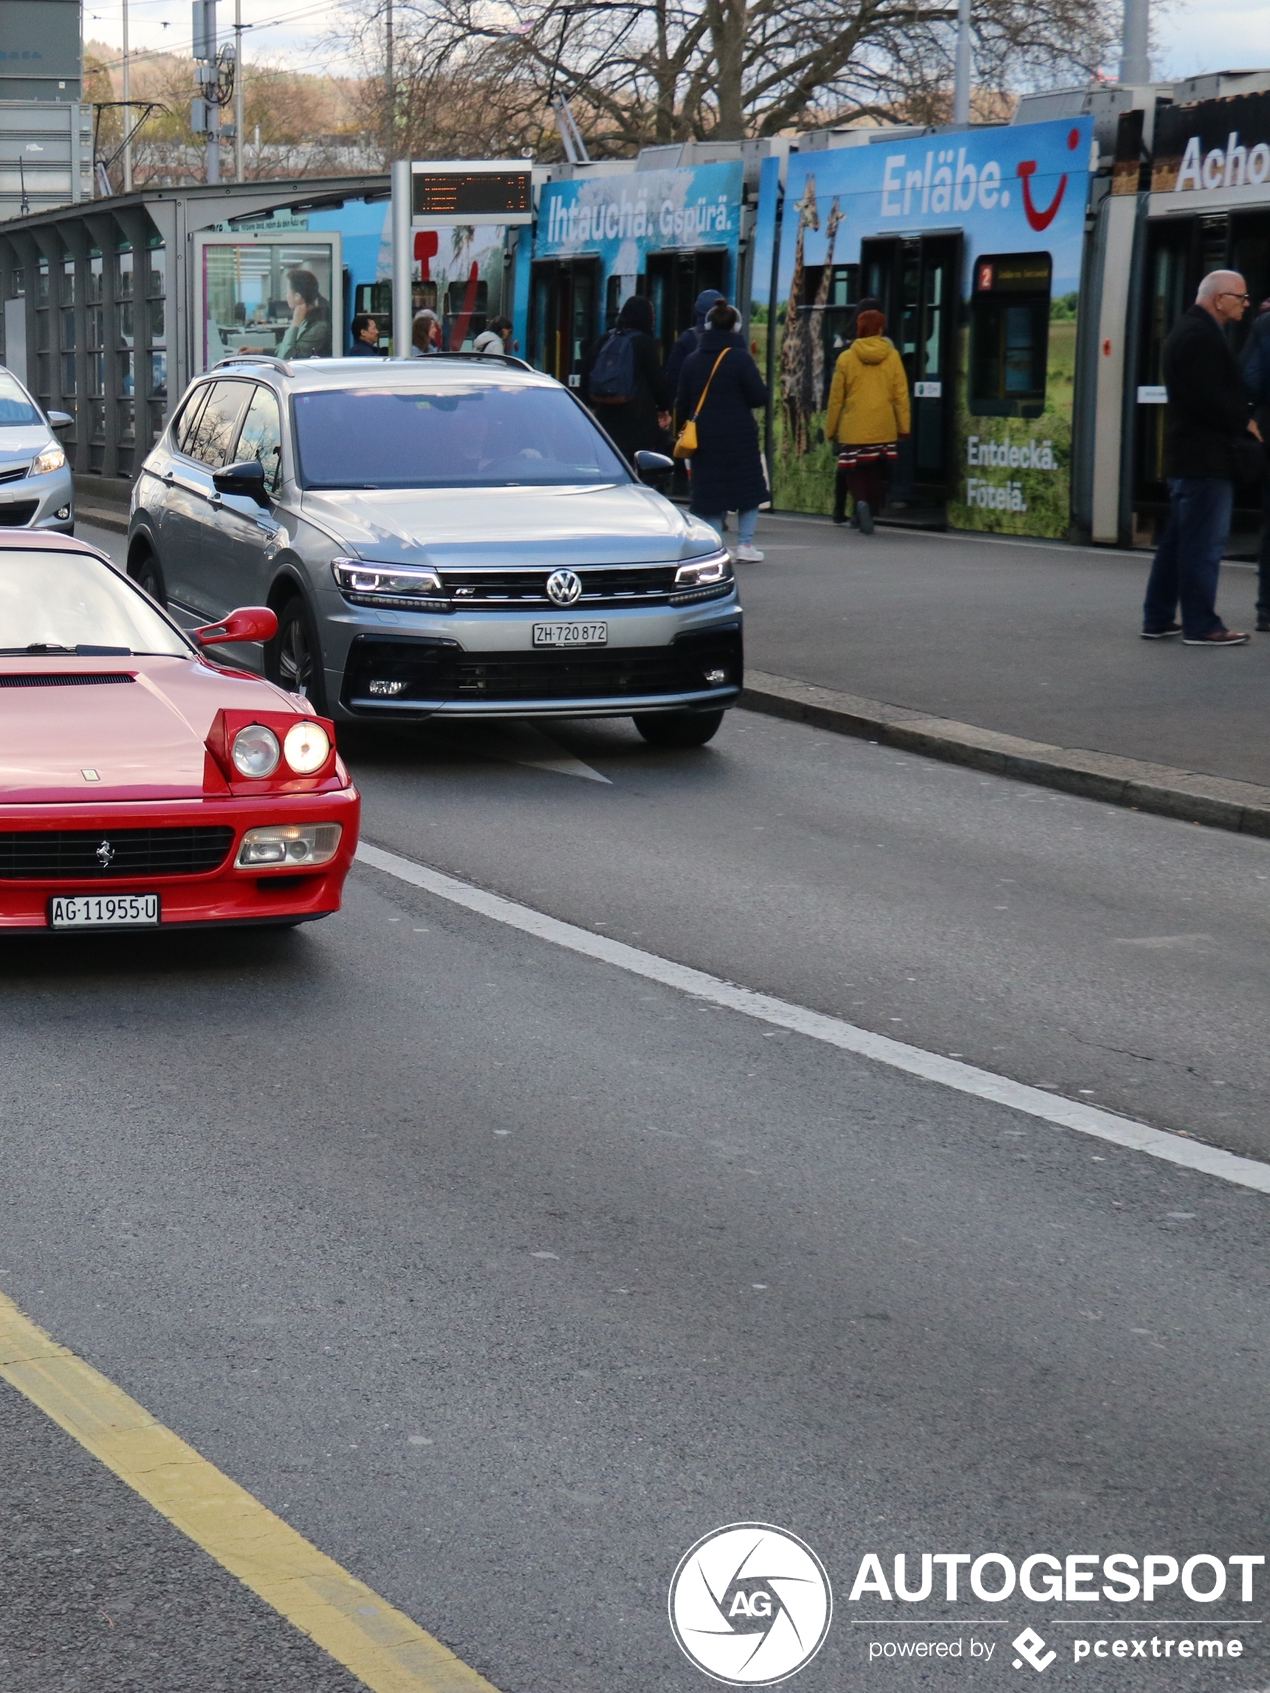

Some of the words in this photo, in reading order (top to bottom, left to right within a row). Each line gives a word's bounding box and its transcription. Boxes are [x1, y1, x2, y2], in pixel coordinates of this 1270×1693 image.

[881, 147, 1010, 217] Erläbe.
[548, 188, 654, 243] Ihtauchä.
[659, 195, 732, 243] Gspürä.
[981, 267, 992, 287] 2
[968, 436, 1058, 471] Entdeckä.
